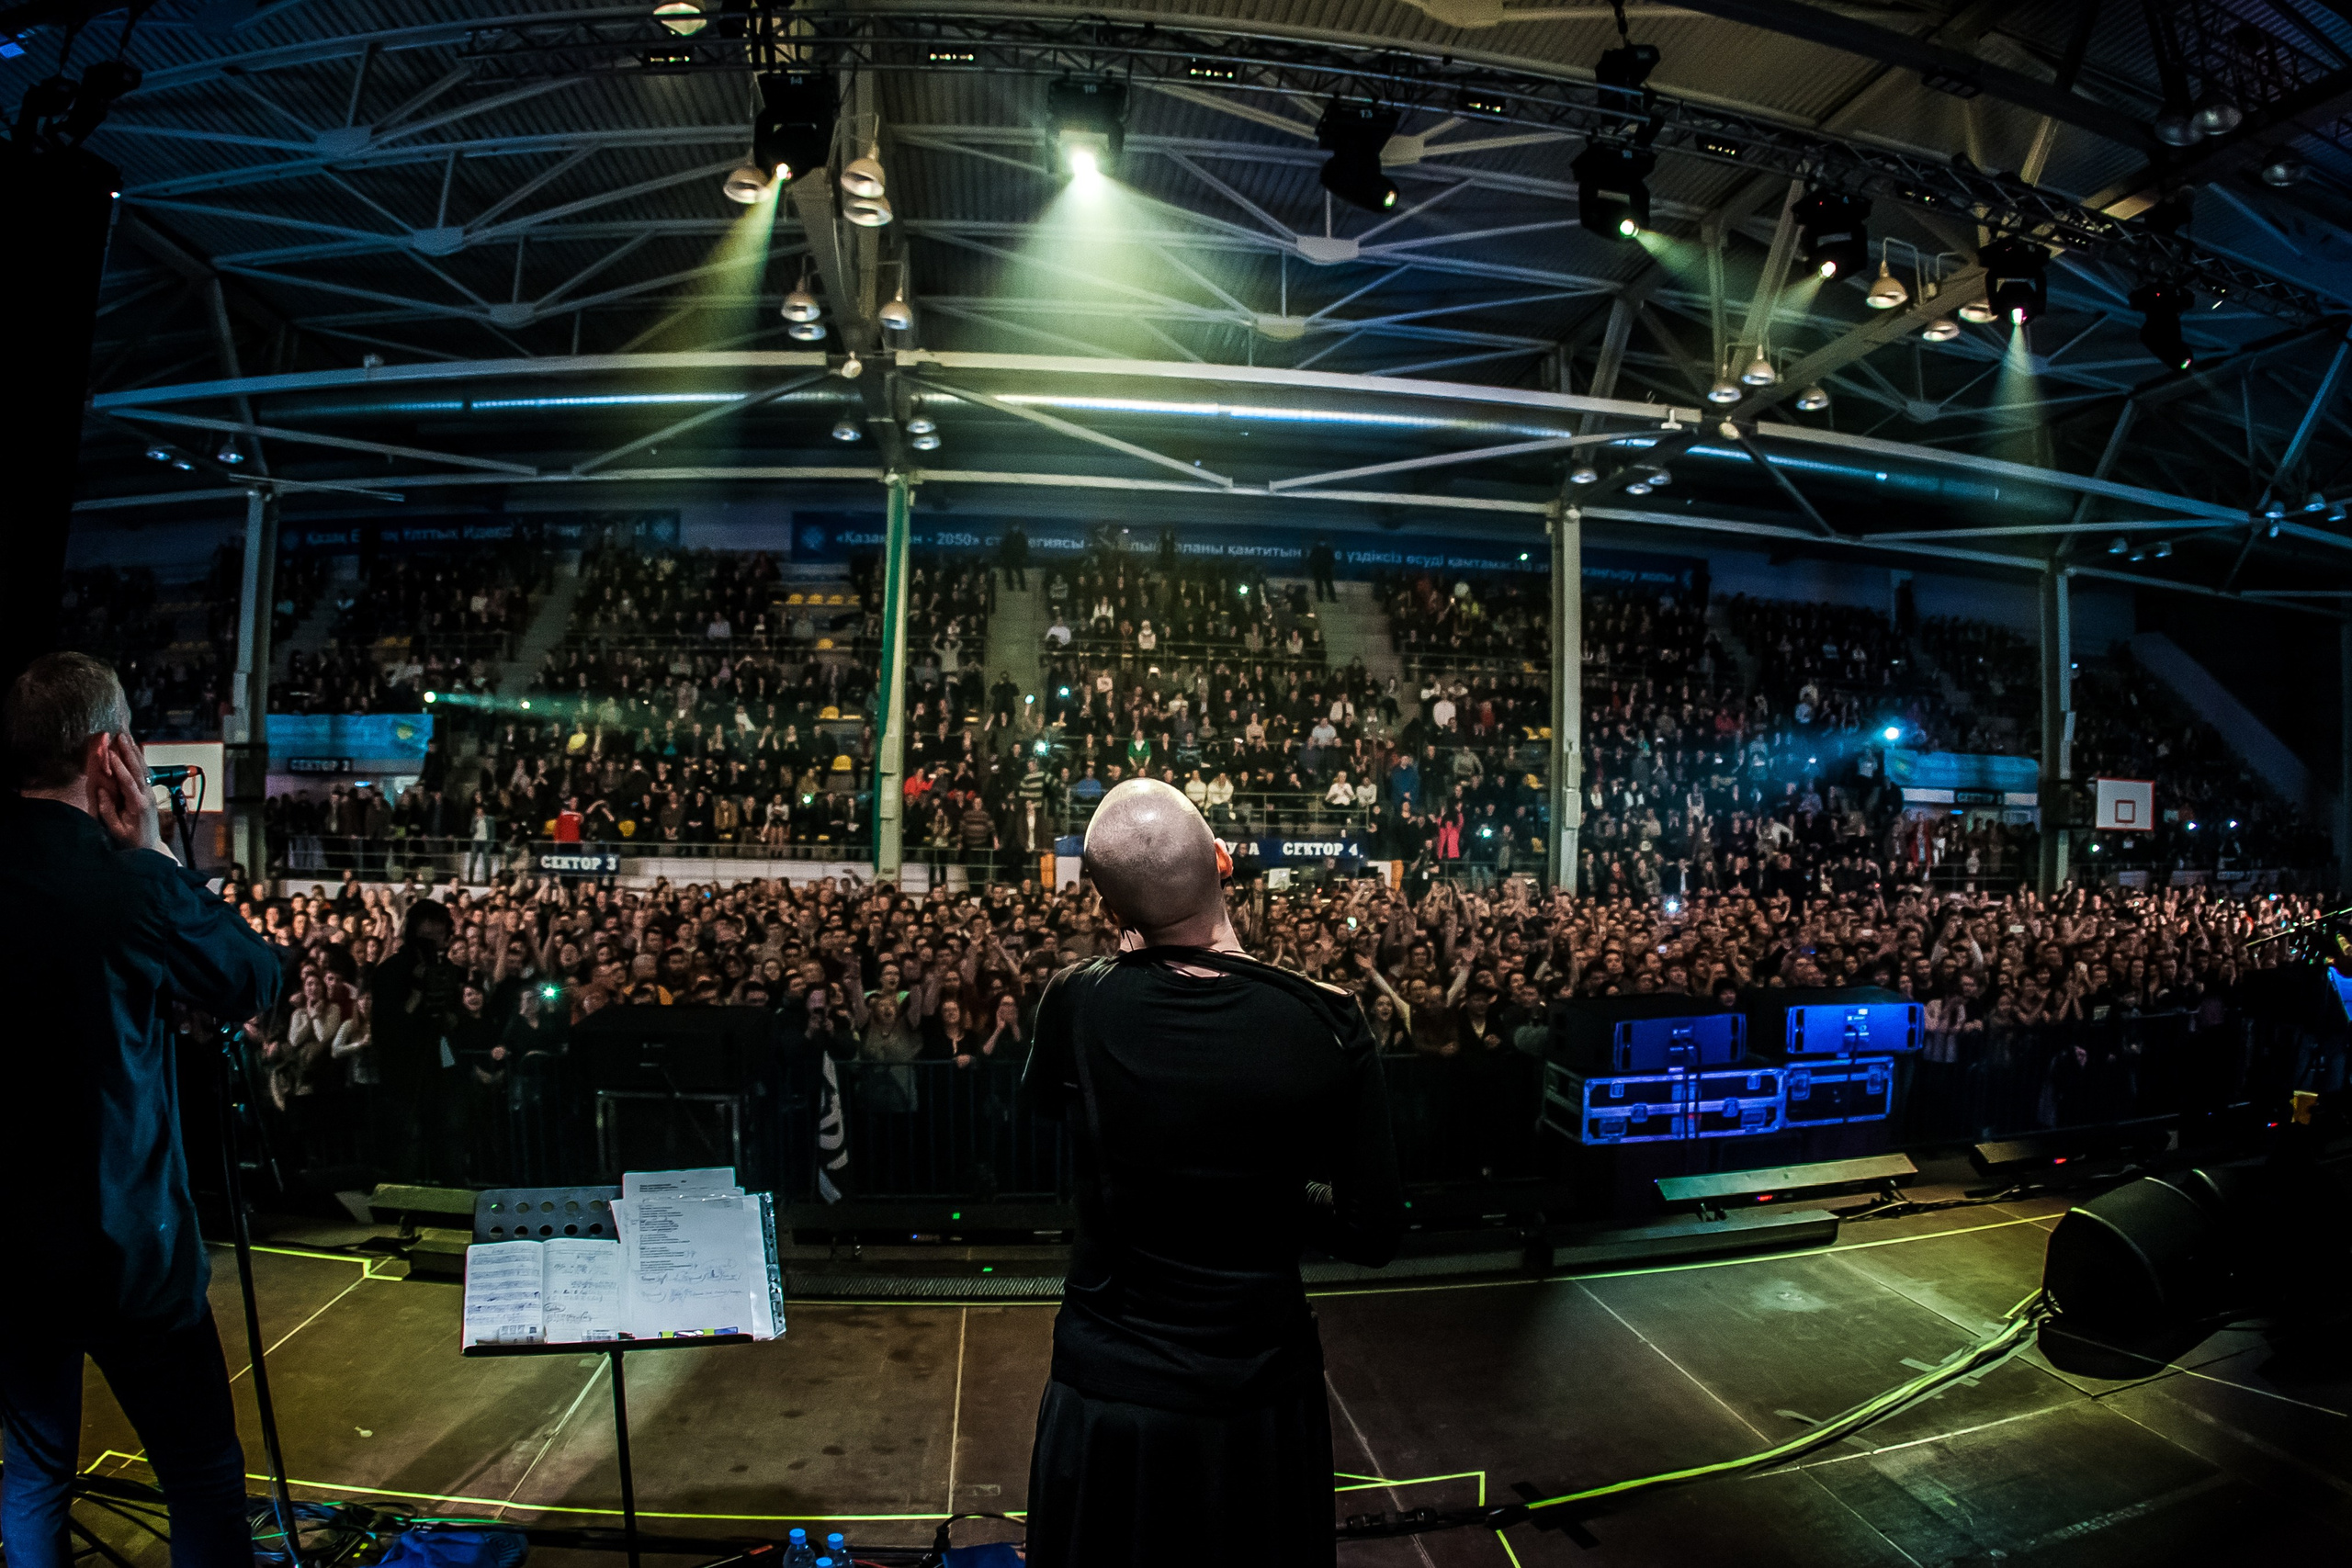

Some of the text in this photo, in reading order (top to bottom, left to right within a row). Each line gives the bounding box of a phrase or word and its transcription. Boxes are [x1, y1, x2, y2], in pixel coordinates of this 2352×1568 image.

[1283, 841, 1344, 857] СЕКТОР
[1348, 842, 1359, 856] 4
[540, 854, 617, 872] СЕКТОР 3
